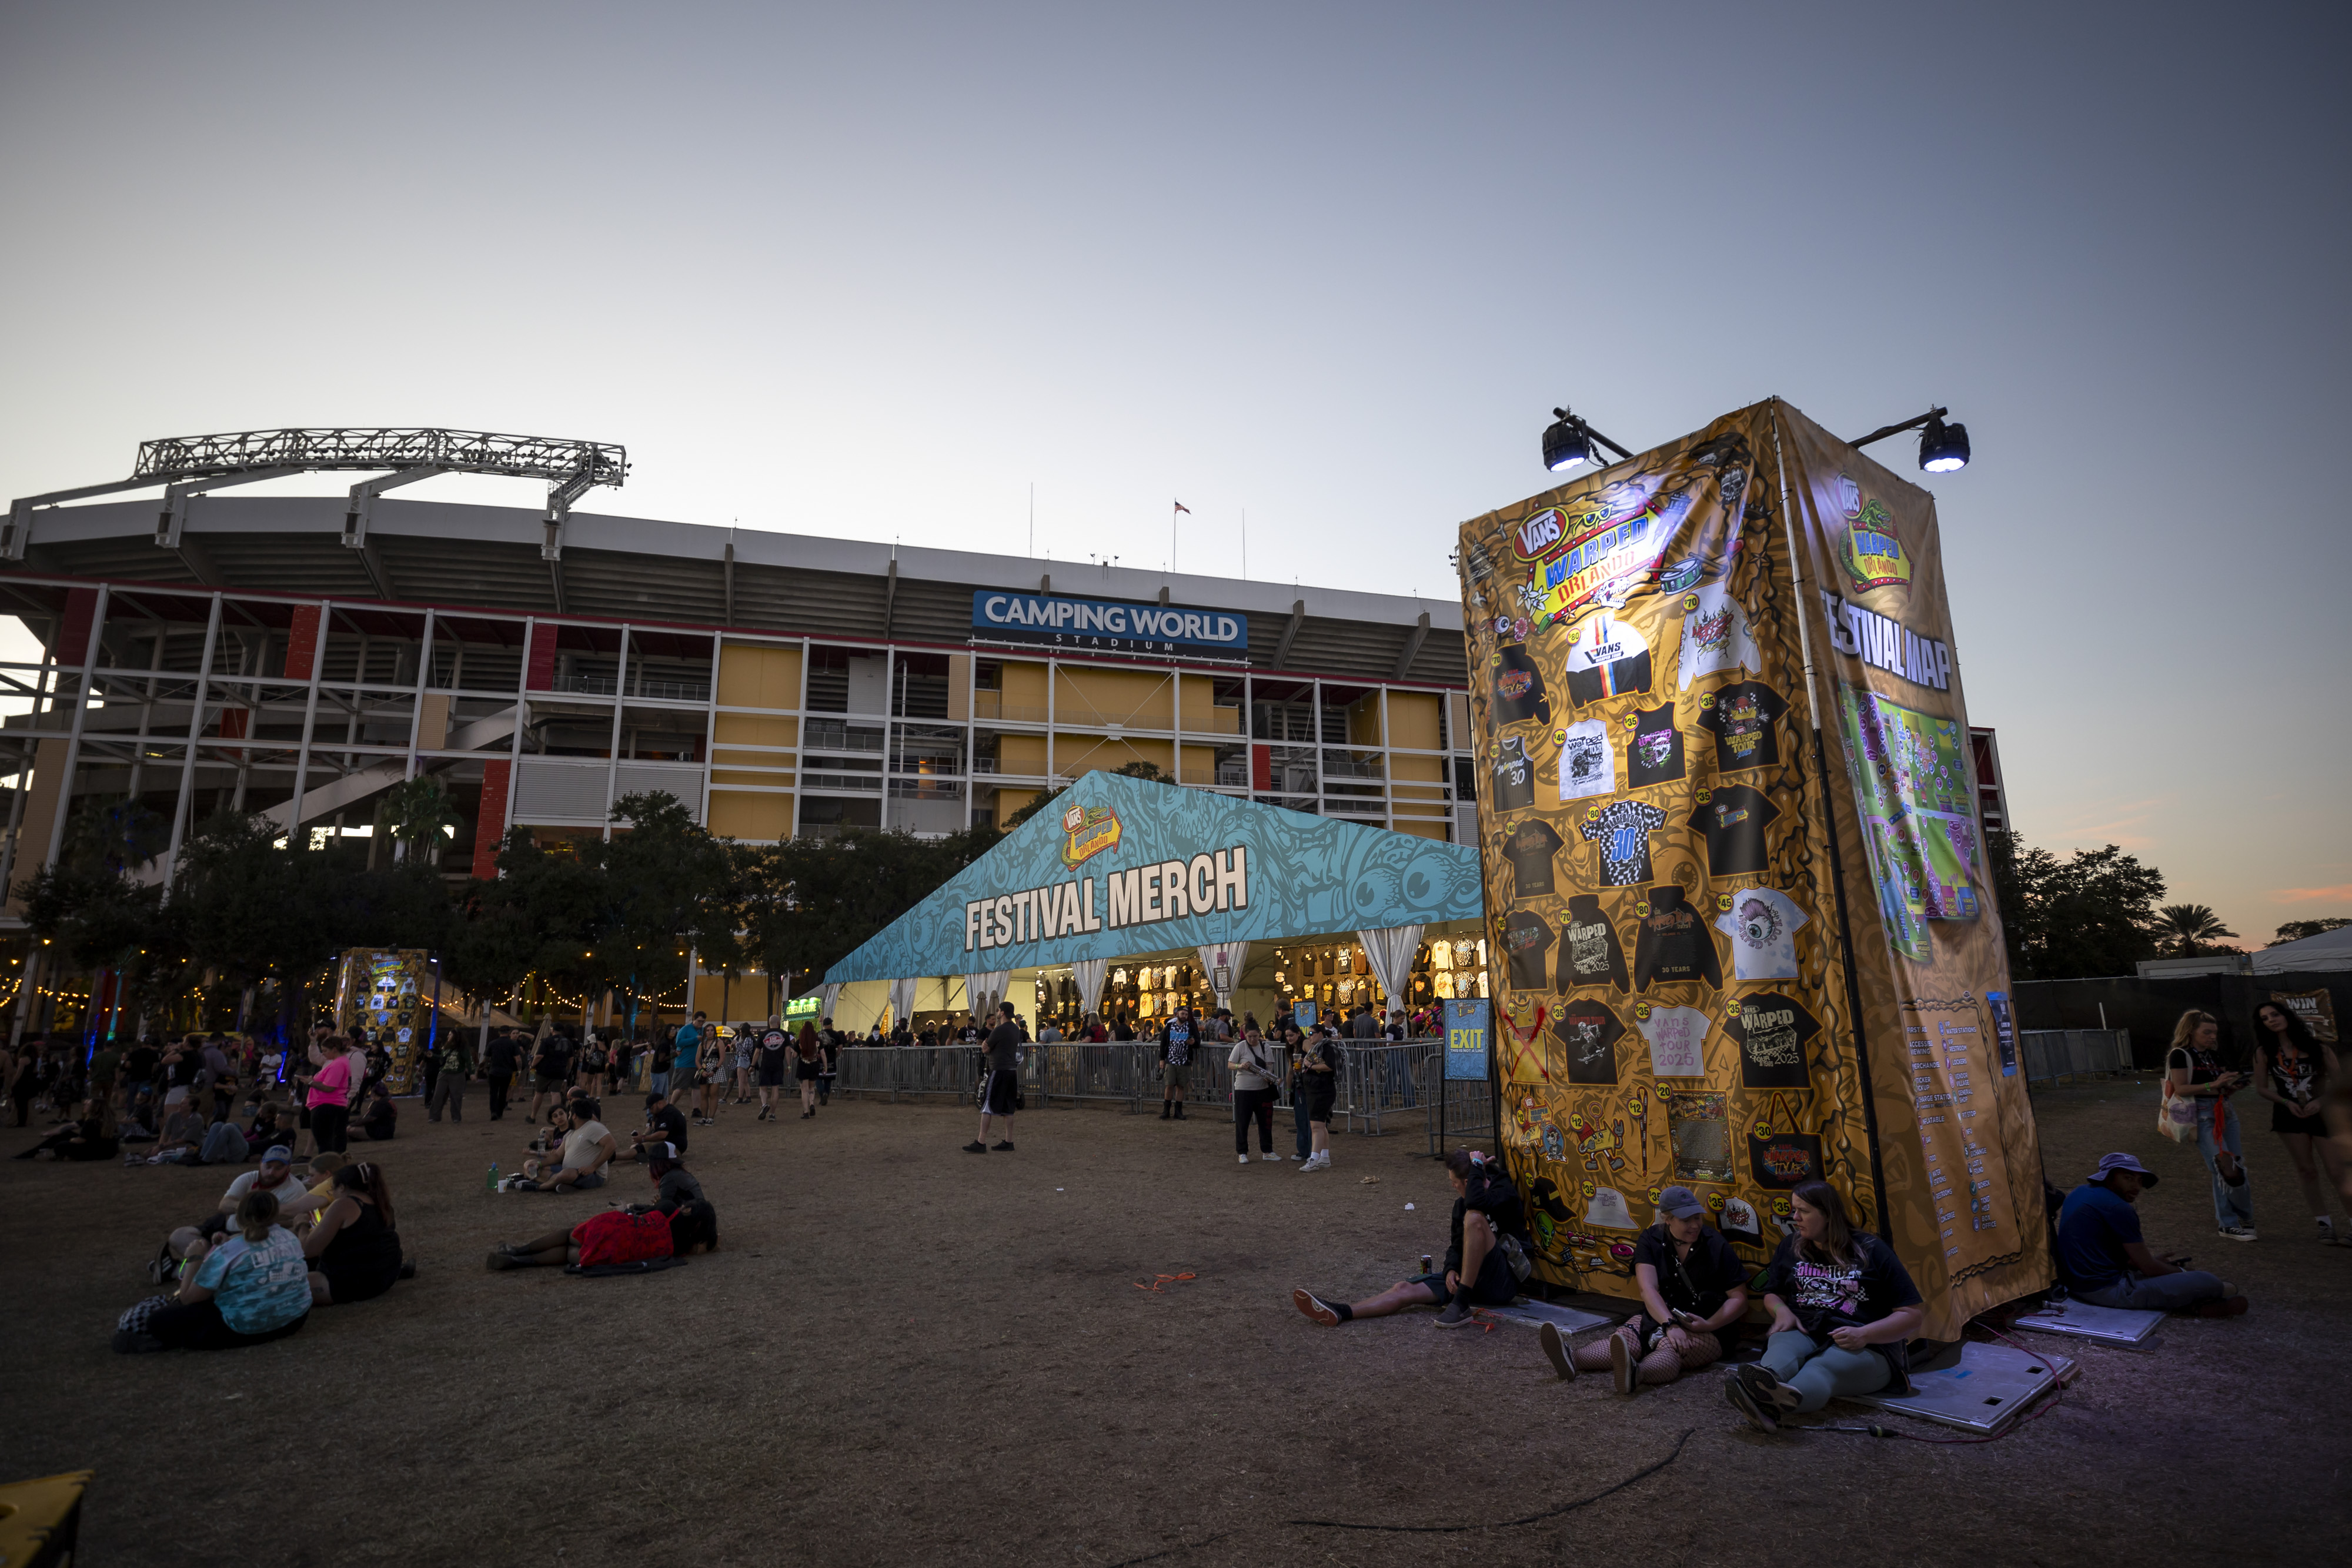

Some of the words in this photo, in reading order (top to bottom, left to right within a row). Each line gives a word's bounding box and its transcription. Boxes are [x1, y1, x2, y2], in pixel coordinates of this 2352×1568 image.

[1837, 477, 1860, 512] VANS
[1518, 509, 1561, 555] VANS
[1853, 531, 1899, 559] WARPED
[1545, 517, 1649, 591] WARPED
[1864, 556, 1898, 576] ORLANDO
[1558, 551, 1635, 604] ORLANDO
[1685, 597, 1697, 607] $70
[985, 596, 1126, 633] CAMPING
[1130, 609, 1238, 642] WORLD
[1055, 634, 1174, 651] STADIUM
[1569, 632, 1579, 641] $80
[1596, 643, 1621, 656] VANS
[1491, 654, 1501, 664] $70
[1905, 629, 1952, 690] MAP
[1700, 697, 1715, 706] $35
[1625, 717, 1637, 726] $35
[1554, 733, 1565, 741] $40
[1725, 731, 1762, 745] WARPED
[1589, 743, 1602, 754] TOUR
[1731, 740, 1756, 753] TOUR
[1498, 757, 1525, 776] Warped
[1511, 768, 1525, 785] 30
[1696, 792, 1710, 801] $35
[1066, 808, 1082, 829] VANS
[1588, 810, 1599, 818] $80
[1075, 820, 1113, 850] WARPED
[1506, 825, 1515, 833] $40
[1078, 835, 1108, 858] ORLANDO
[1611, 827, 1636, 862] 30
[966, 878, 1101, 950] FESTIVAL
[1109, 847, 1247, 927] MERCH
[1717, 897, 1732, 907] $45
[1636, 905, 1649, 914] $80
[1560, 912, 1571, 921] $70
[1567, 923, 1606, 941] WARPED
[1738, 914, 1763, 950] WARPED
[1765, 919, 1783, 947] TOUR
[1591, 961, 1609, 972] 2025
[786, 1005, 803, 1015] GENERAL
[803, 1003, 817, 1013] STORE
[1727, 1003, 1740, 1013] $35
[2286, 997, 2317, 1009] WIN
[1553, 1008, 1564, 1017] $35
[1636, 1006, 1649, 1016] $35
[1591, 1016, 1606, 1025] TOUR
[1740, 1009, 1794, 1029] WARPED
[1450, 1029, 1484, 1049] EXIT
[1659, 1053, 1694, 1066] 2025
[1775, 1052, 1799, 1064] 2025
[1656, 1085, 1671, 1096] $20
[1629, 1102, 1641, 1113] $12
[1571, 1117, 1582, 1127] $12
[1755, 1125, 1771, 1136] $30
[1764, 1150, 1809, 1164] WARPED
[1770, 1162, 1805, 1175] TOUR
[1583, 1184, 1595, 1194] $35
[1980, 1179, 1990, 1188] CHECK
[1936, 1188, 1952, 1199] RESTROOMS
[1708, 1196, 1723, 1208] $35
[1773, 1201, 1790, 1212] $35
[1981, 1203, 1990, 1212] HELP
[1982, 1221, 1997, 1230] OFFICE
